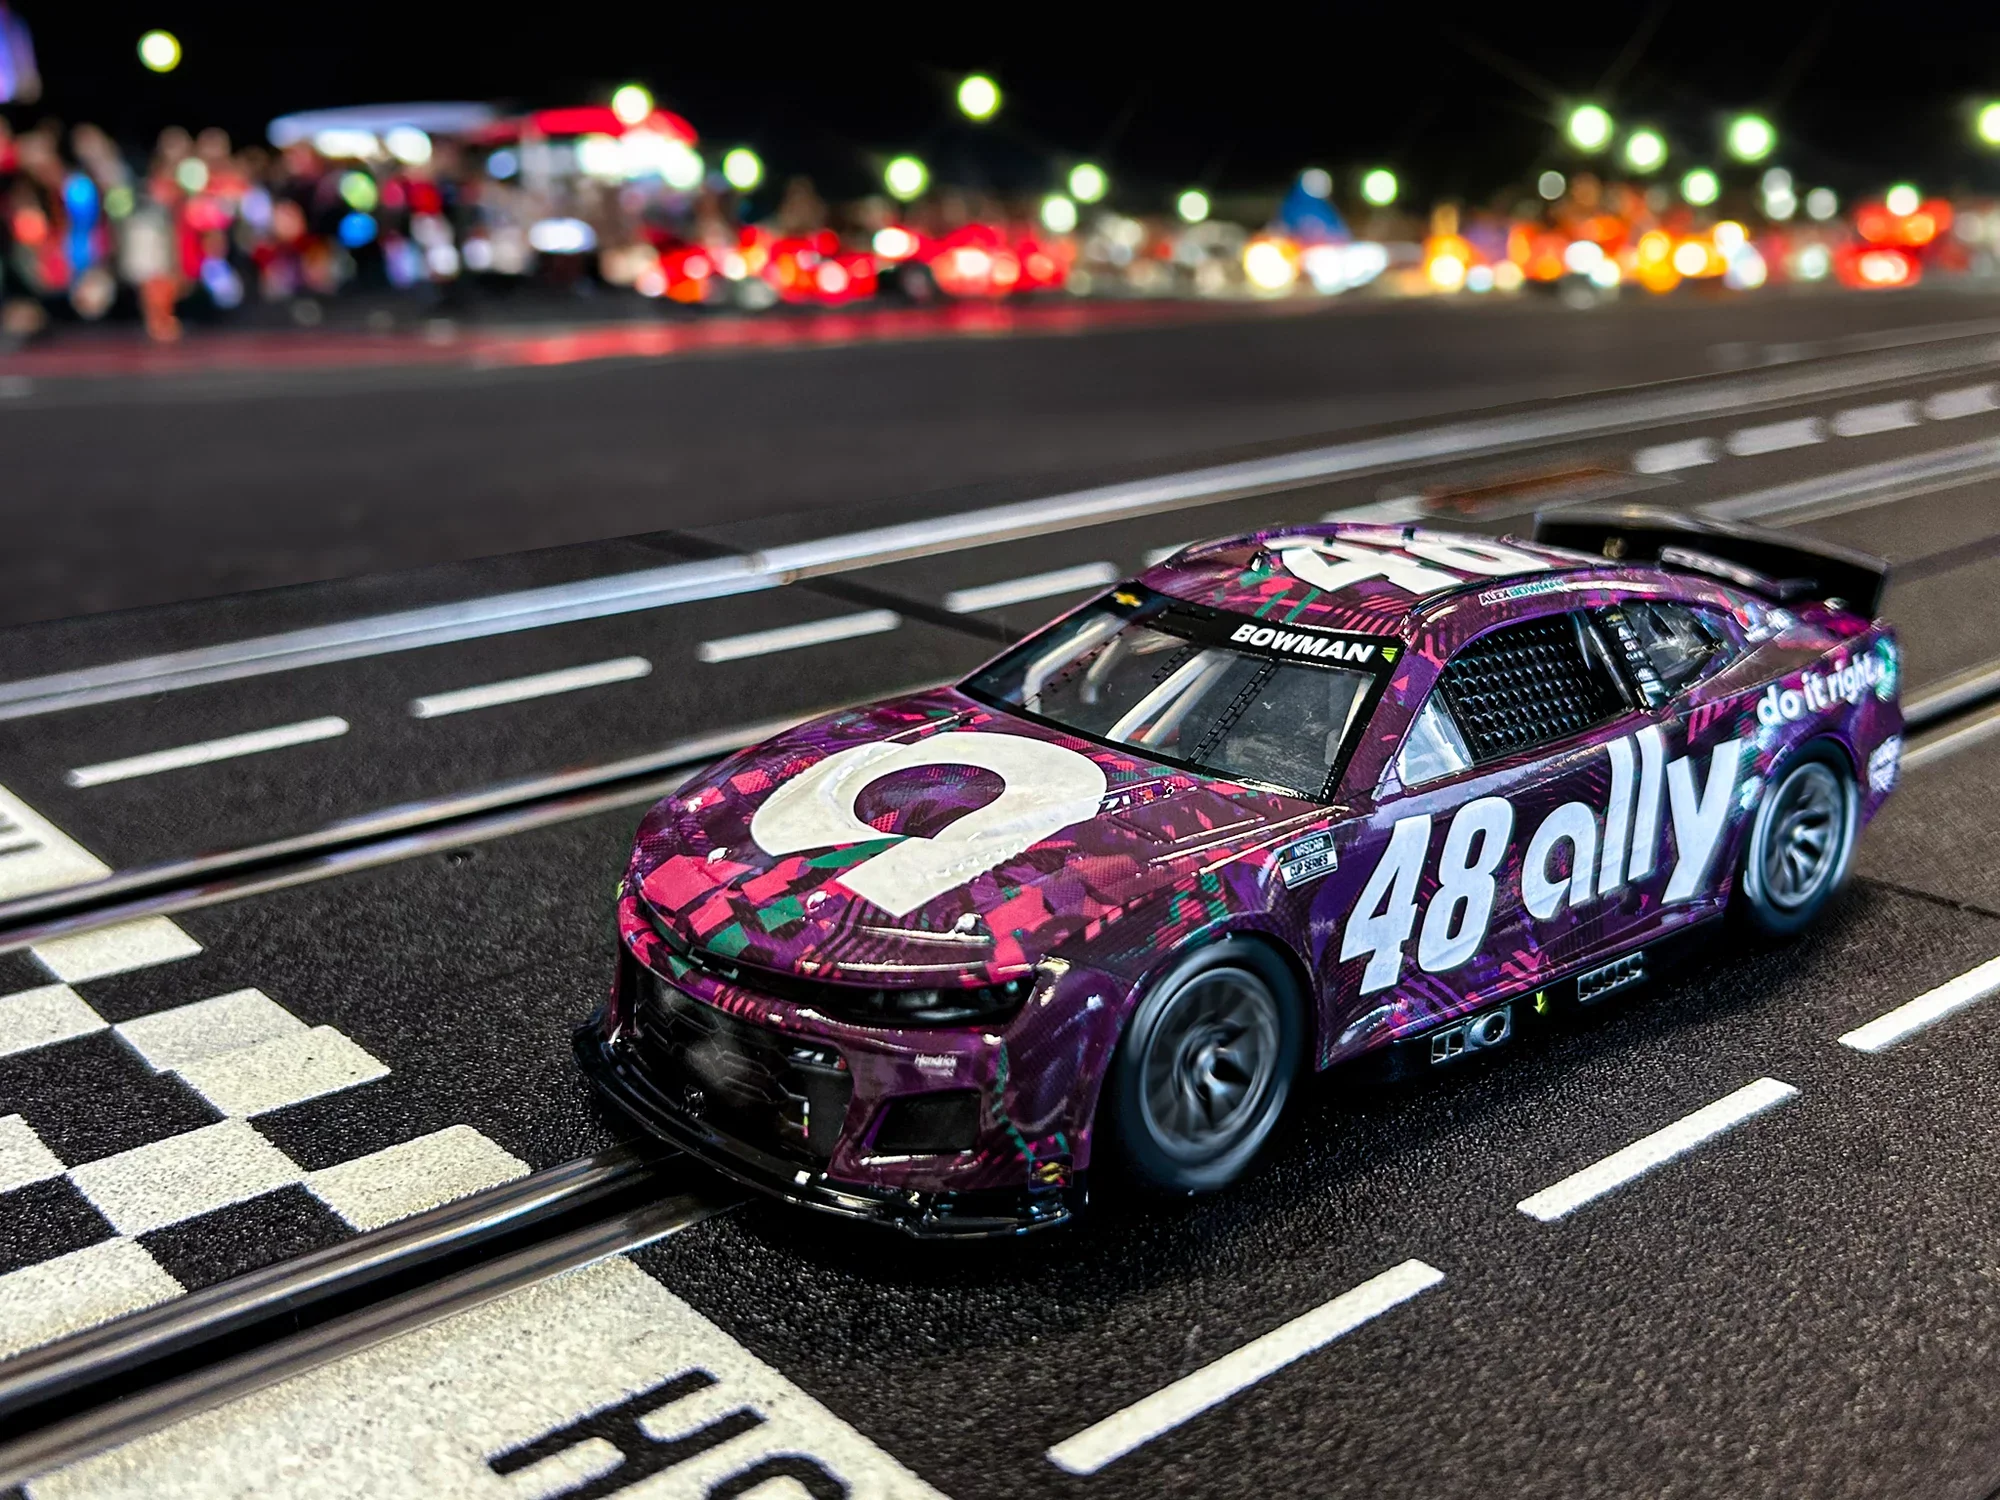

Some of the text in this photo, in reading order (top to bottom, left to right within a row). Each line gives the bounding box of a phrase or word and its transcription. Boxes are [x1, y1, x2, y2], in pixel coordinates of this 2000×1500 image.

[1230, 622, 1375, 664] BOWMAN
[1756, 684, 1804, 726] do
[1801, 671, 1827, 712] it
[1338, 724, 1742, 996] 48 ally
